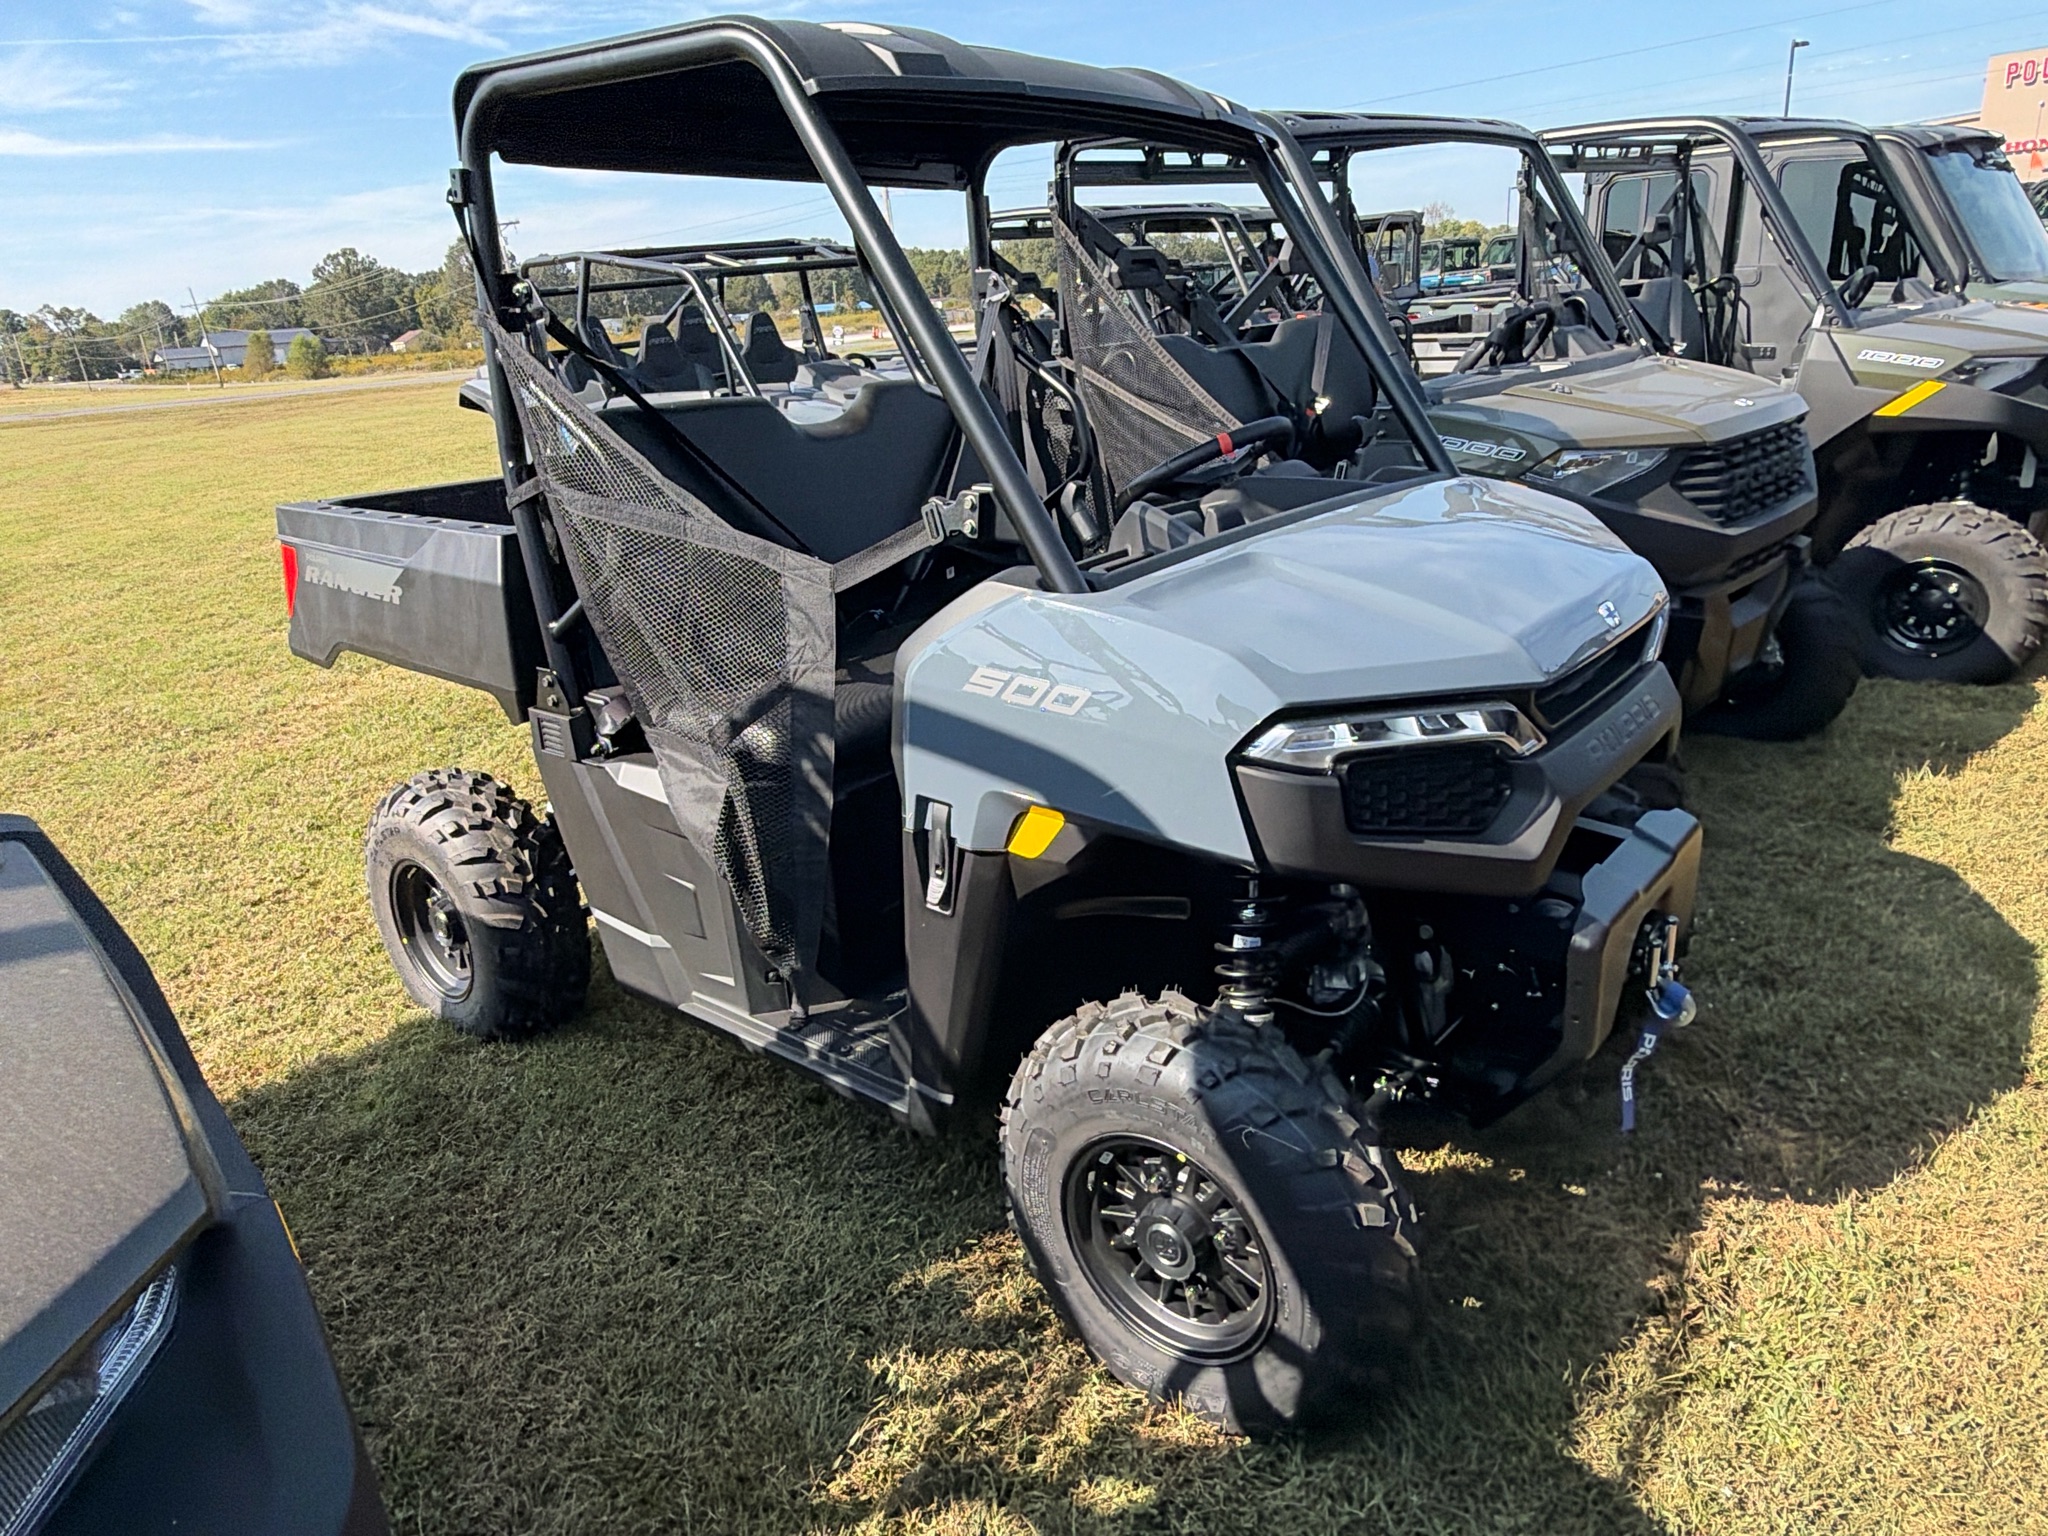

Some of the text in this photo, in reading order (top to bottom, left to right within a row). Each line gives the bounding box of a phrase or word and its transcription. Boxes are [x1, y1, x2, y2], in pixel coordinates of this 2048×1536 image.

[1857, 349, 1945, 369] 1000
[1437, 434, 1527, 462] 000
[961, 666, 1092, 716] 500
